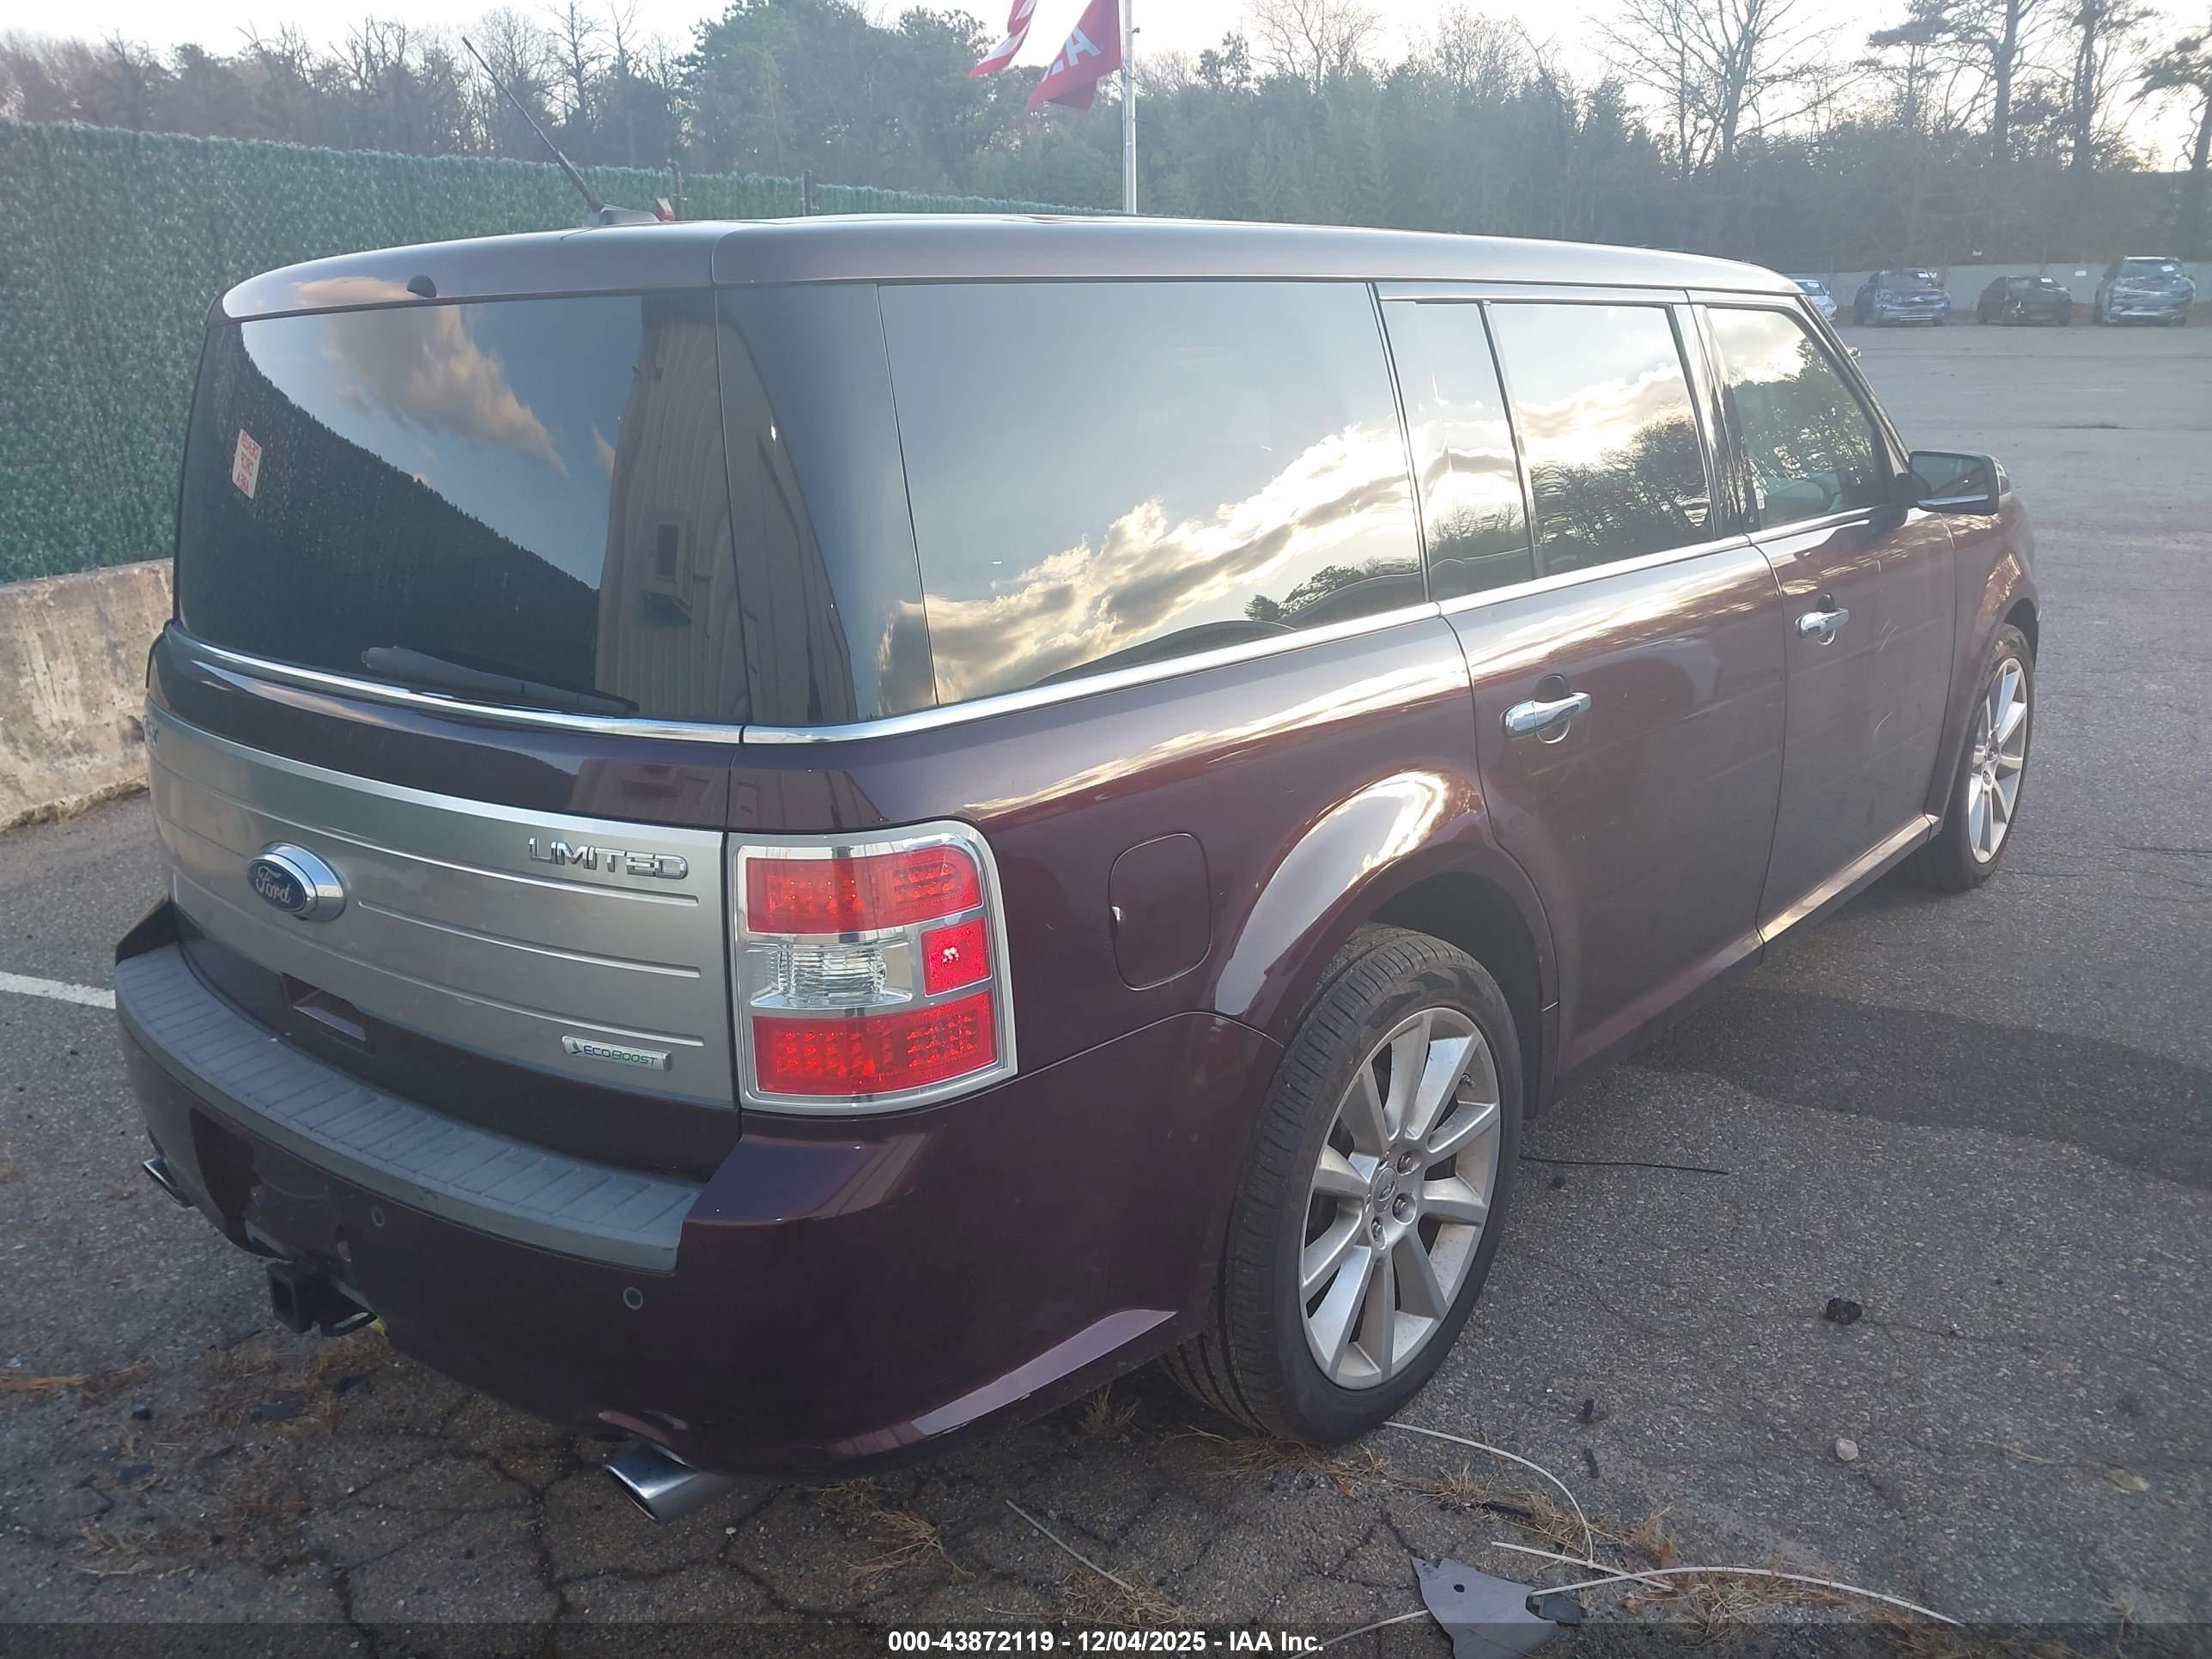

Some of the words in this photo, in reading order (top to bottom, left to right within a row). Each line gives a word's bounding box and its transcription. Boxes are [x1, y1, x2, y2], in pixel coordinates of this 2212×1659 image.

[528, 837, 688, 880] LIMITED
[255, 866, 292, 904] Ford
[584, 1044, 659, 1066] ECOBOOST
